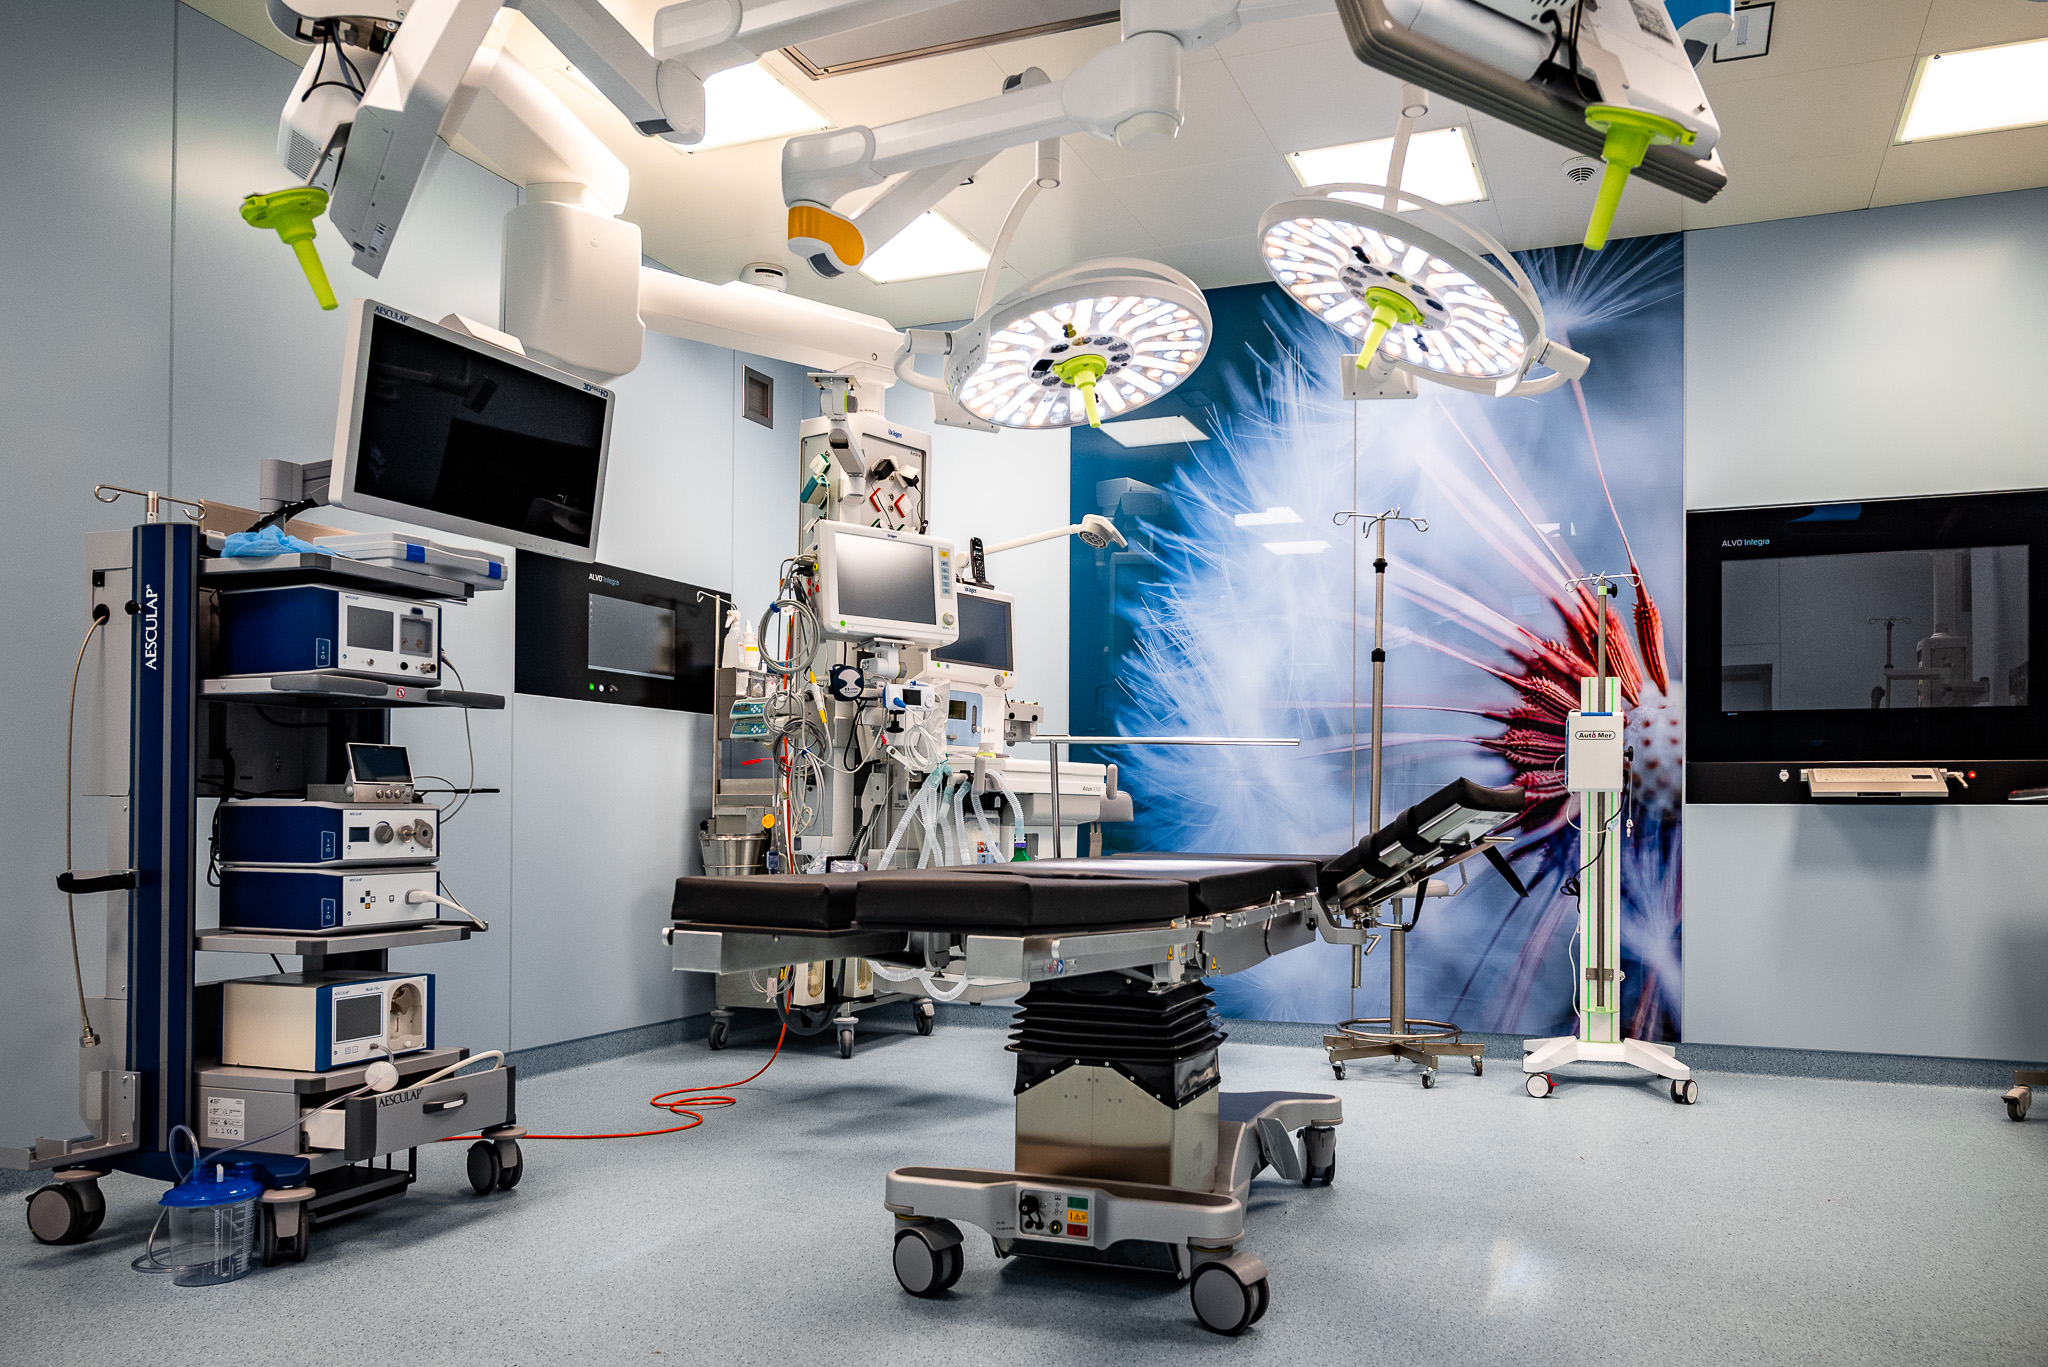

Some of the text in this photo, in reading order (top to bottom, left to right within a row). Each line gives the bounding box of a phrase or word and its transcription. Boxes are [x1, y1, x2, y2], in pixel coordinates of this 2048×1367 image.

[375, 305, 409, 323] AESCULAP
[583, 383, 592, 391] 3D
[1721, 538, 1770, 547] ALVO Integra
[589, 573, 603, 582] ALVO
[378, 1087, 424, 1108] AESCULAP
